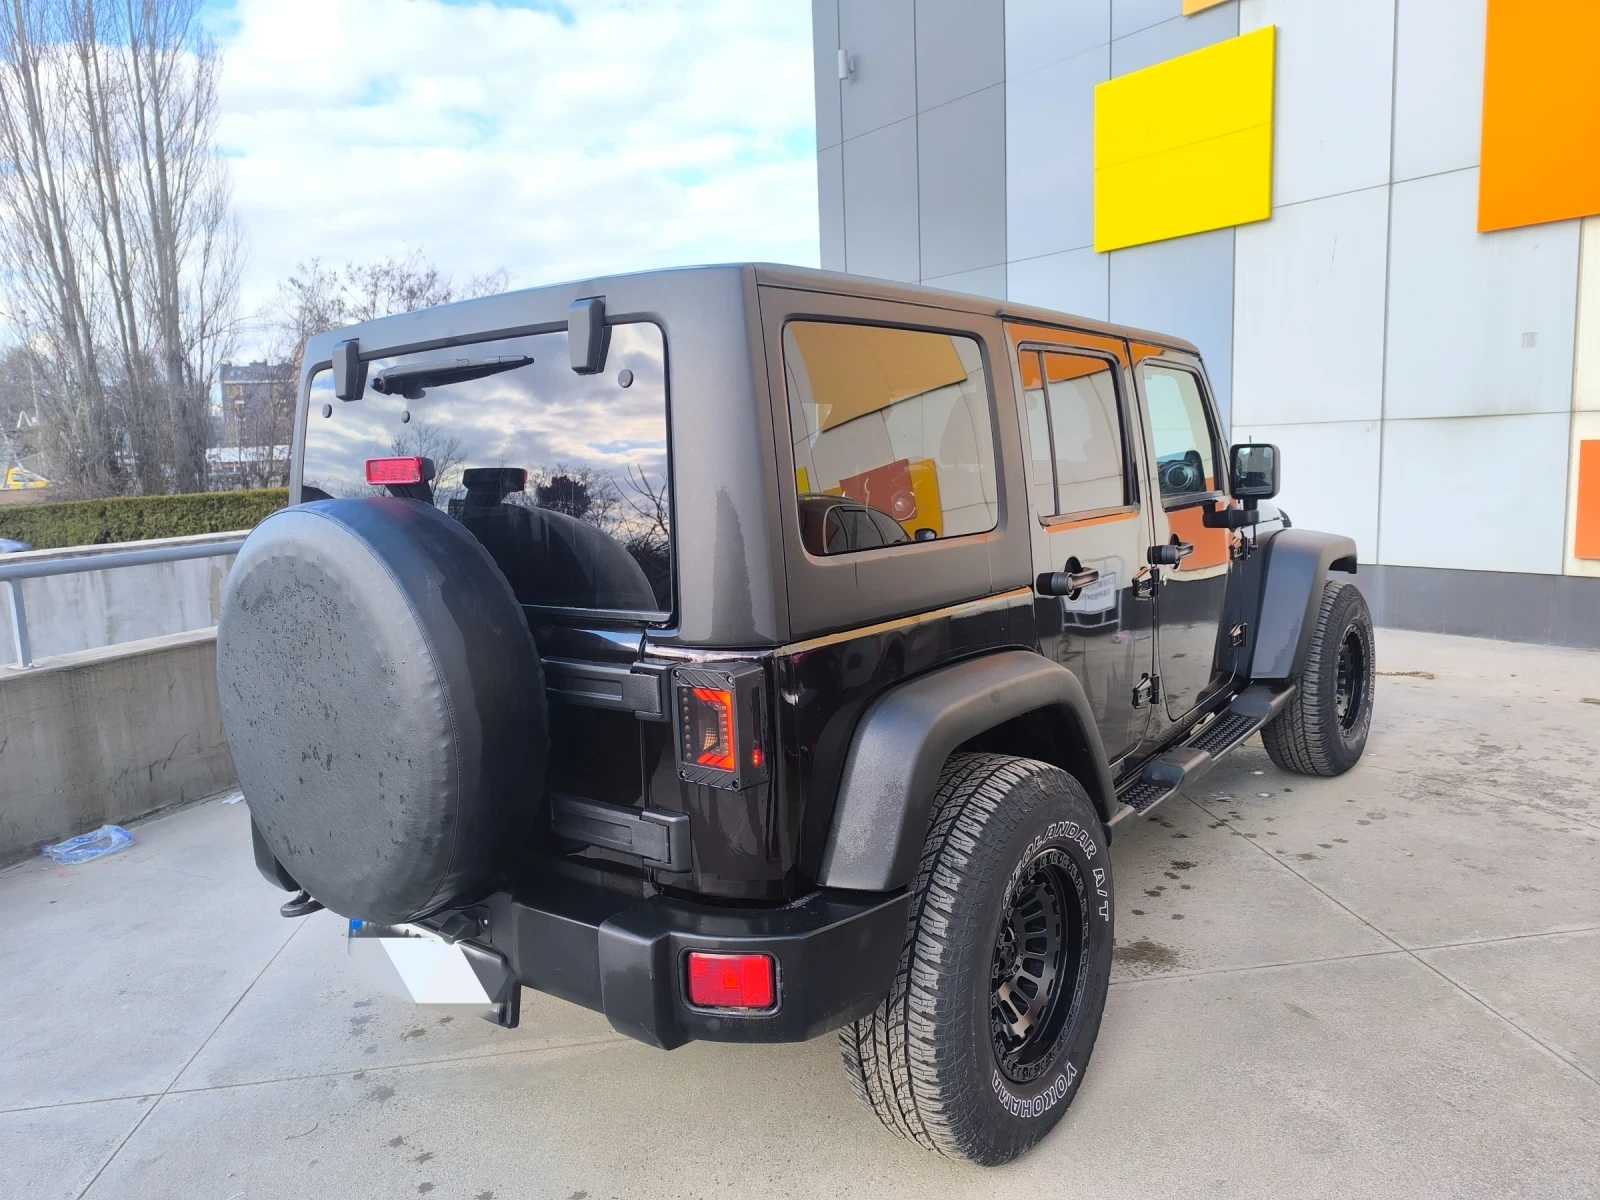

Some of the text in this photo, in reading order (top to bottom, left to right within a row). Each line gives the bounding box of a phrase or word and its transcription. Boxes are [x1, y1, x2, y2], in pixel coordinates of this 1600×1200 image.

[1003, 821, 1109, 921] GEOLANDAR A/T
[991, 1062, 1078, 1118] YOKOHAMA
